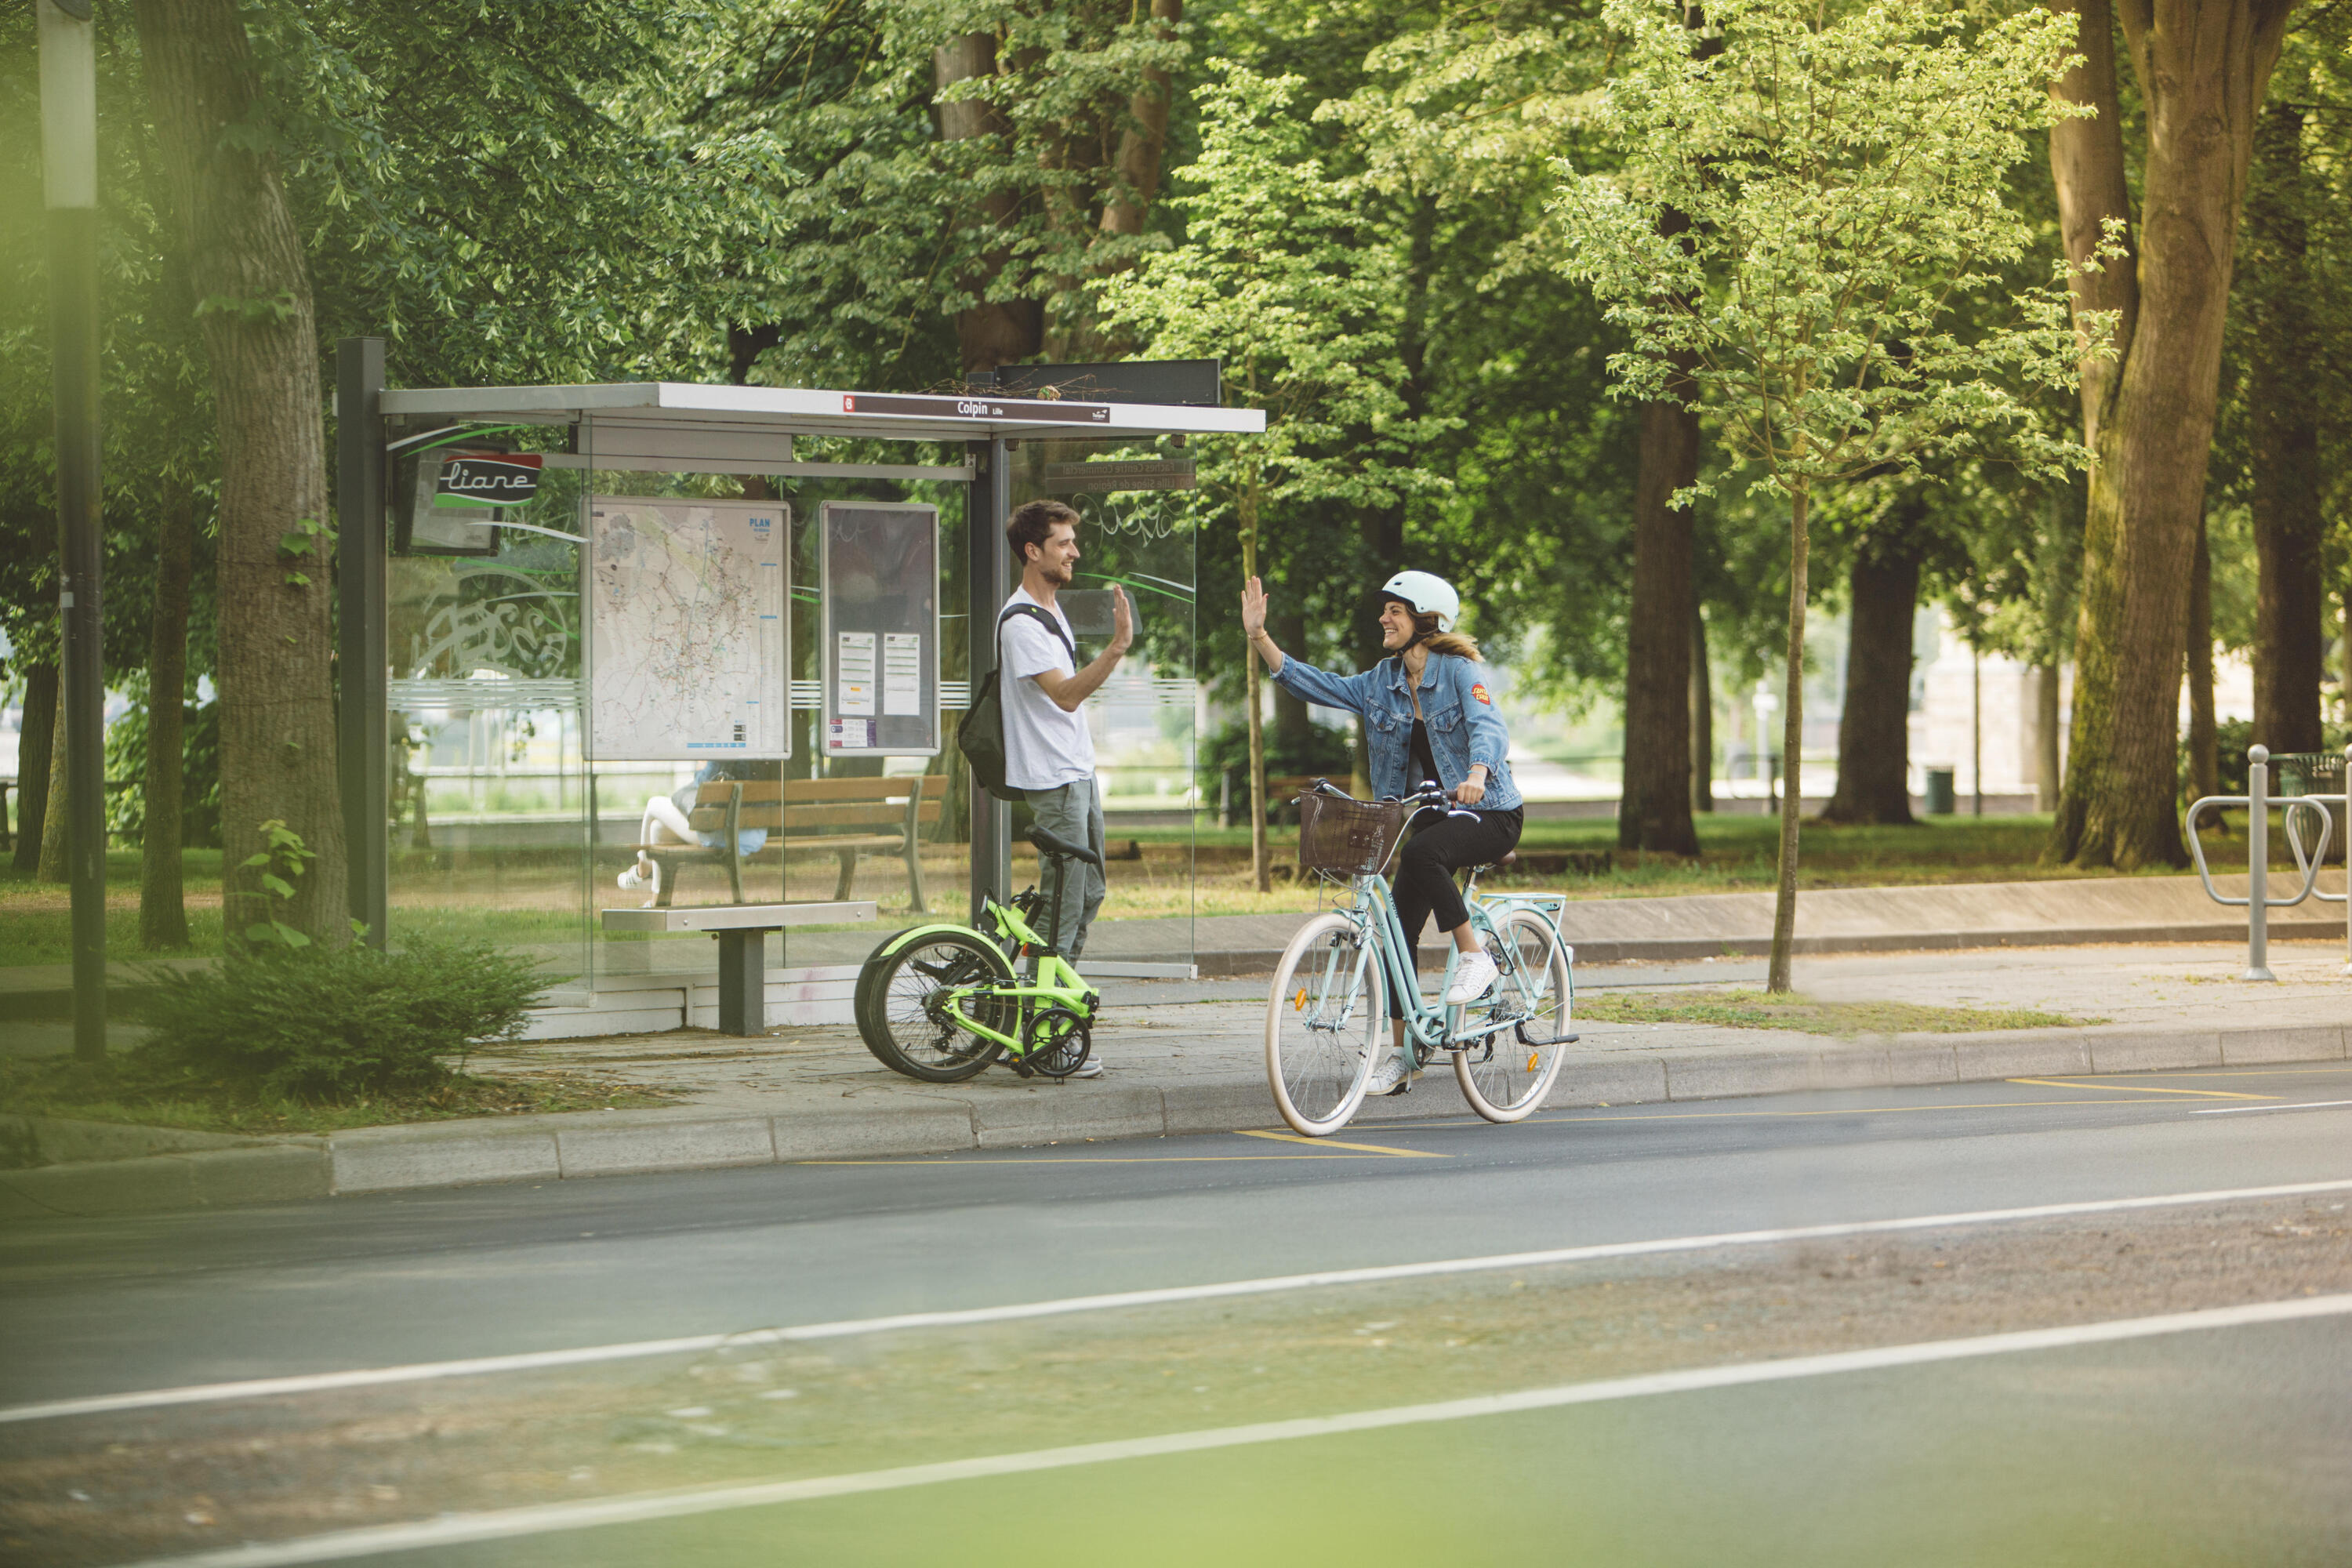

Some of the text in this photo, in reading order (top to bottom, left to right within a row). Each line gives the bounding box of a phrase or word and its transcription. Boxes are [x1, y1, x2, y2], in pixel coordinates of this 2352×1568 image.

[957, 401, 988, 418] Colpin
[439, 462, 537, 489] liane
[749, 517, 771, 528] PLAN
